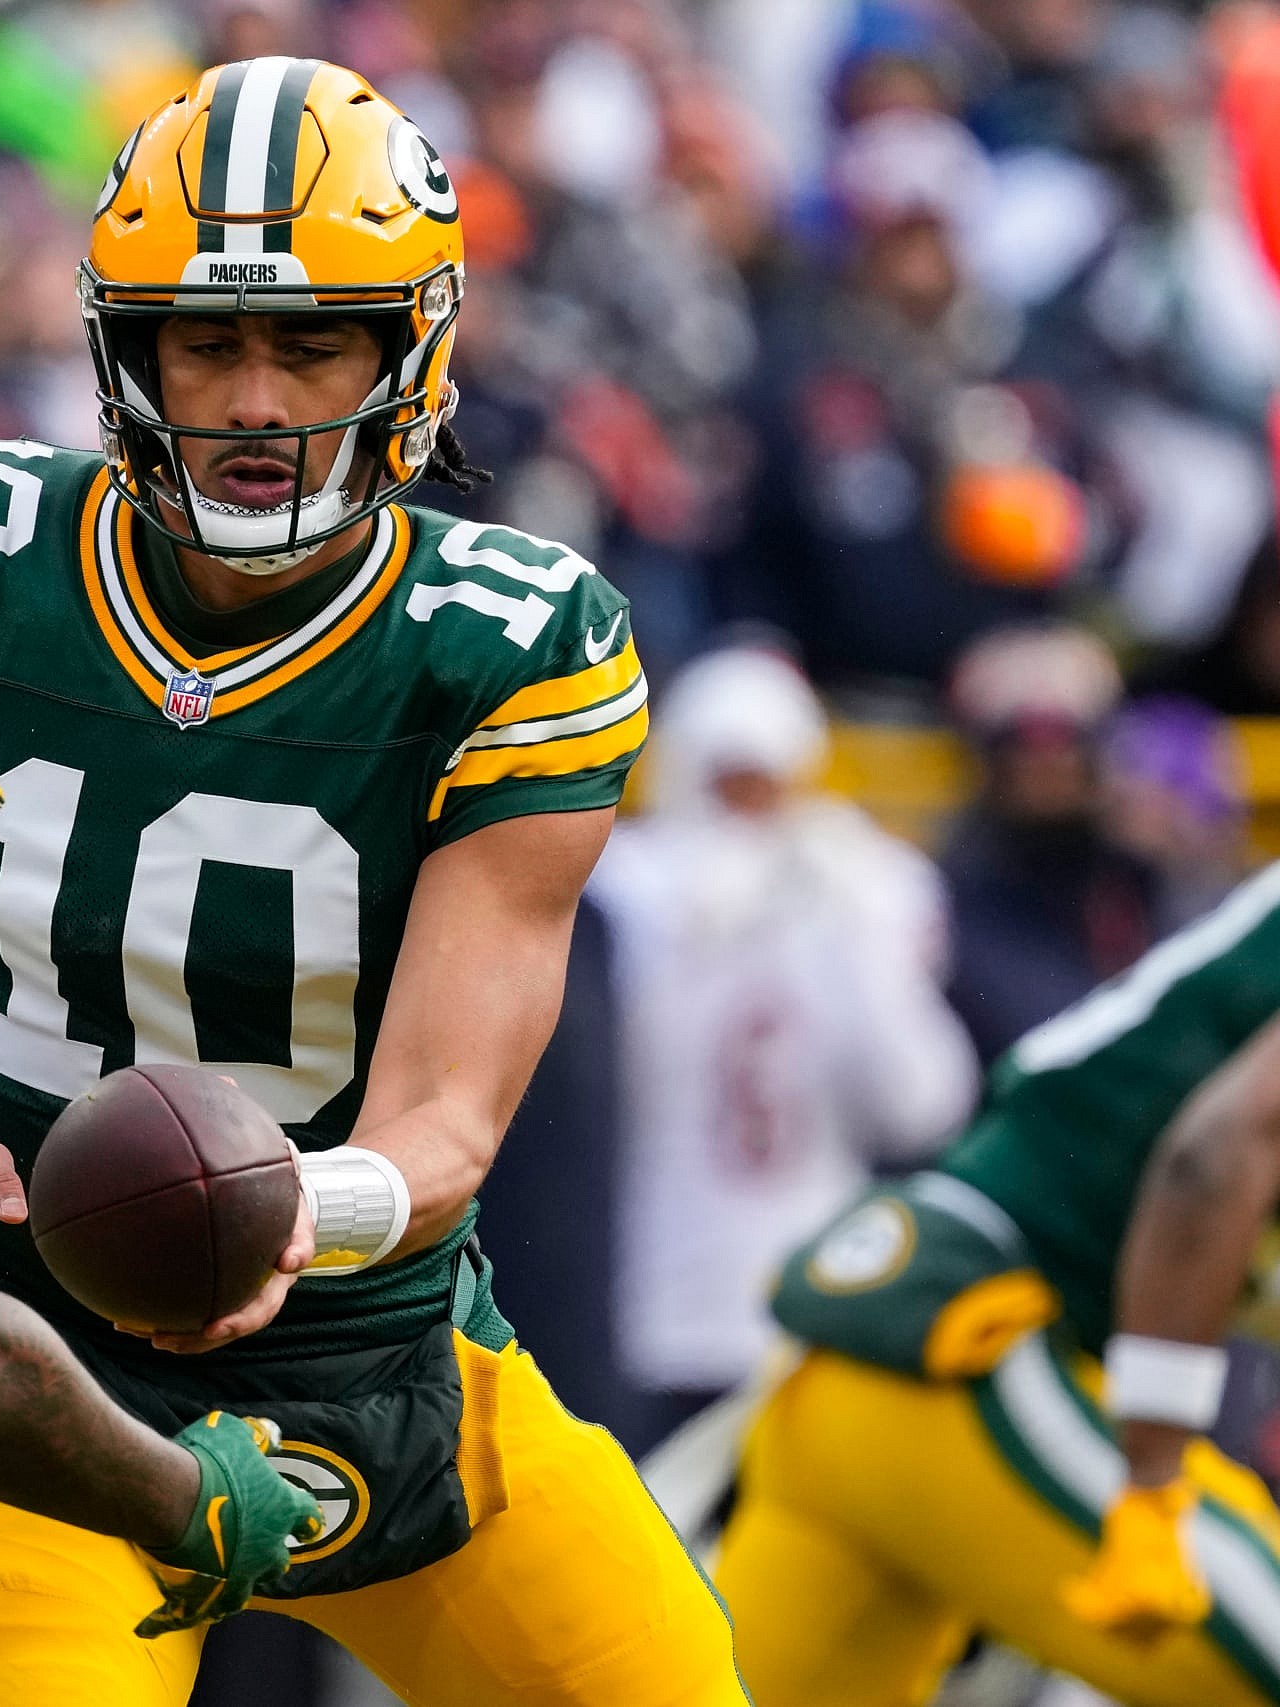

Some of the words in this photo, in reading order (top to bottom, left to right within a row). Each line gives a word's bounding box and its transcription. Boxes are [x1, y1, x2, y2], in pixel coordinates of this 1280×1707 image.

[209, 263, 277, 283] PACKERS
[405, 521, 596, 651] 10
[169, 693, 202, 719] NFL
